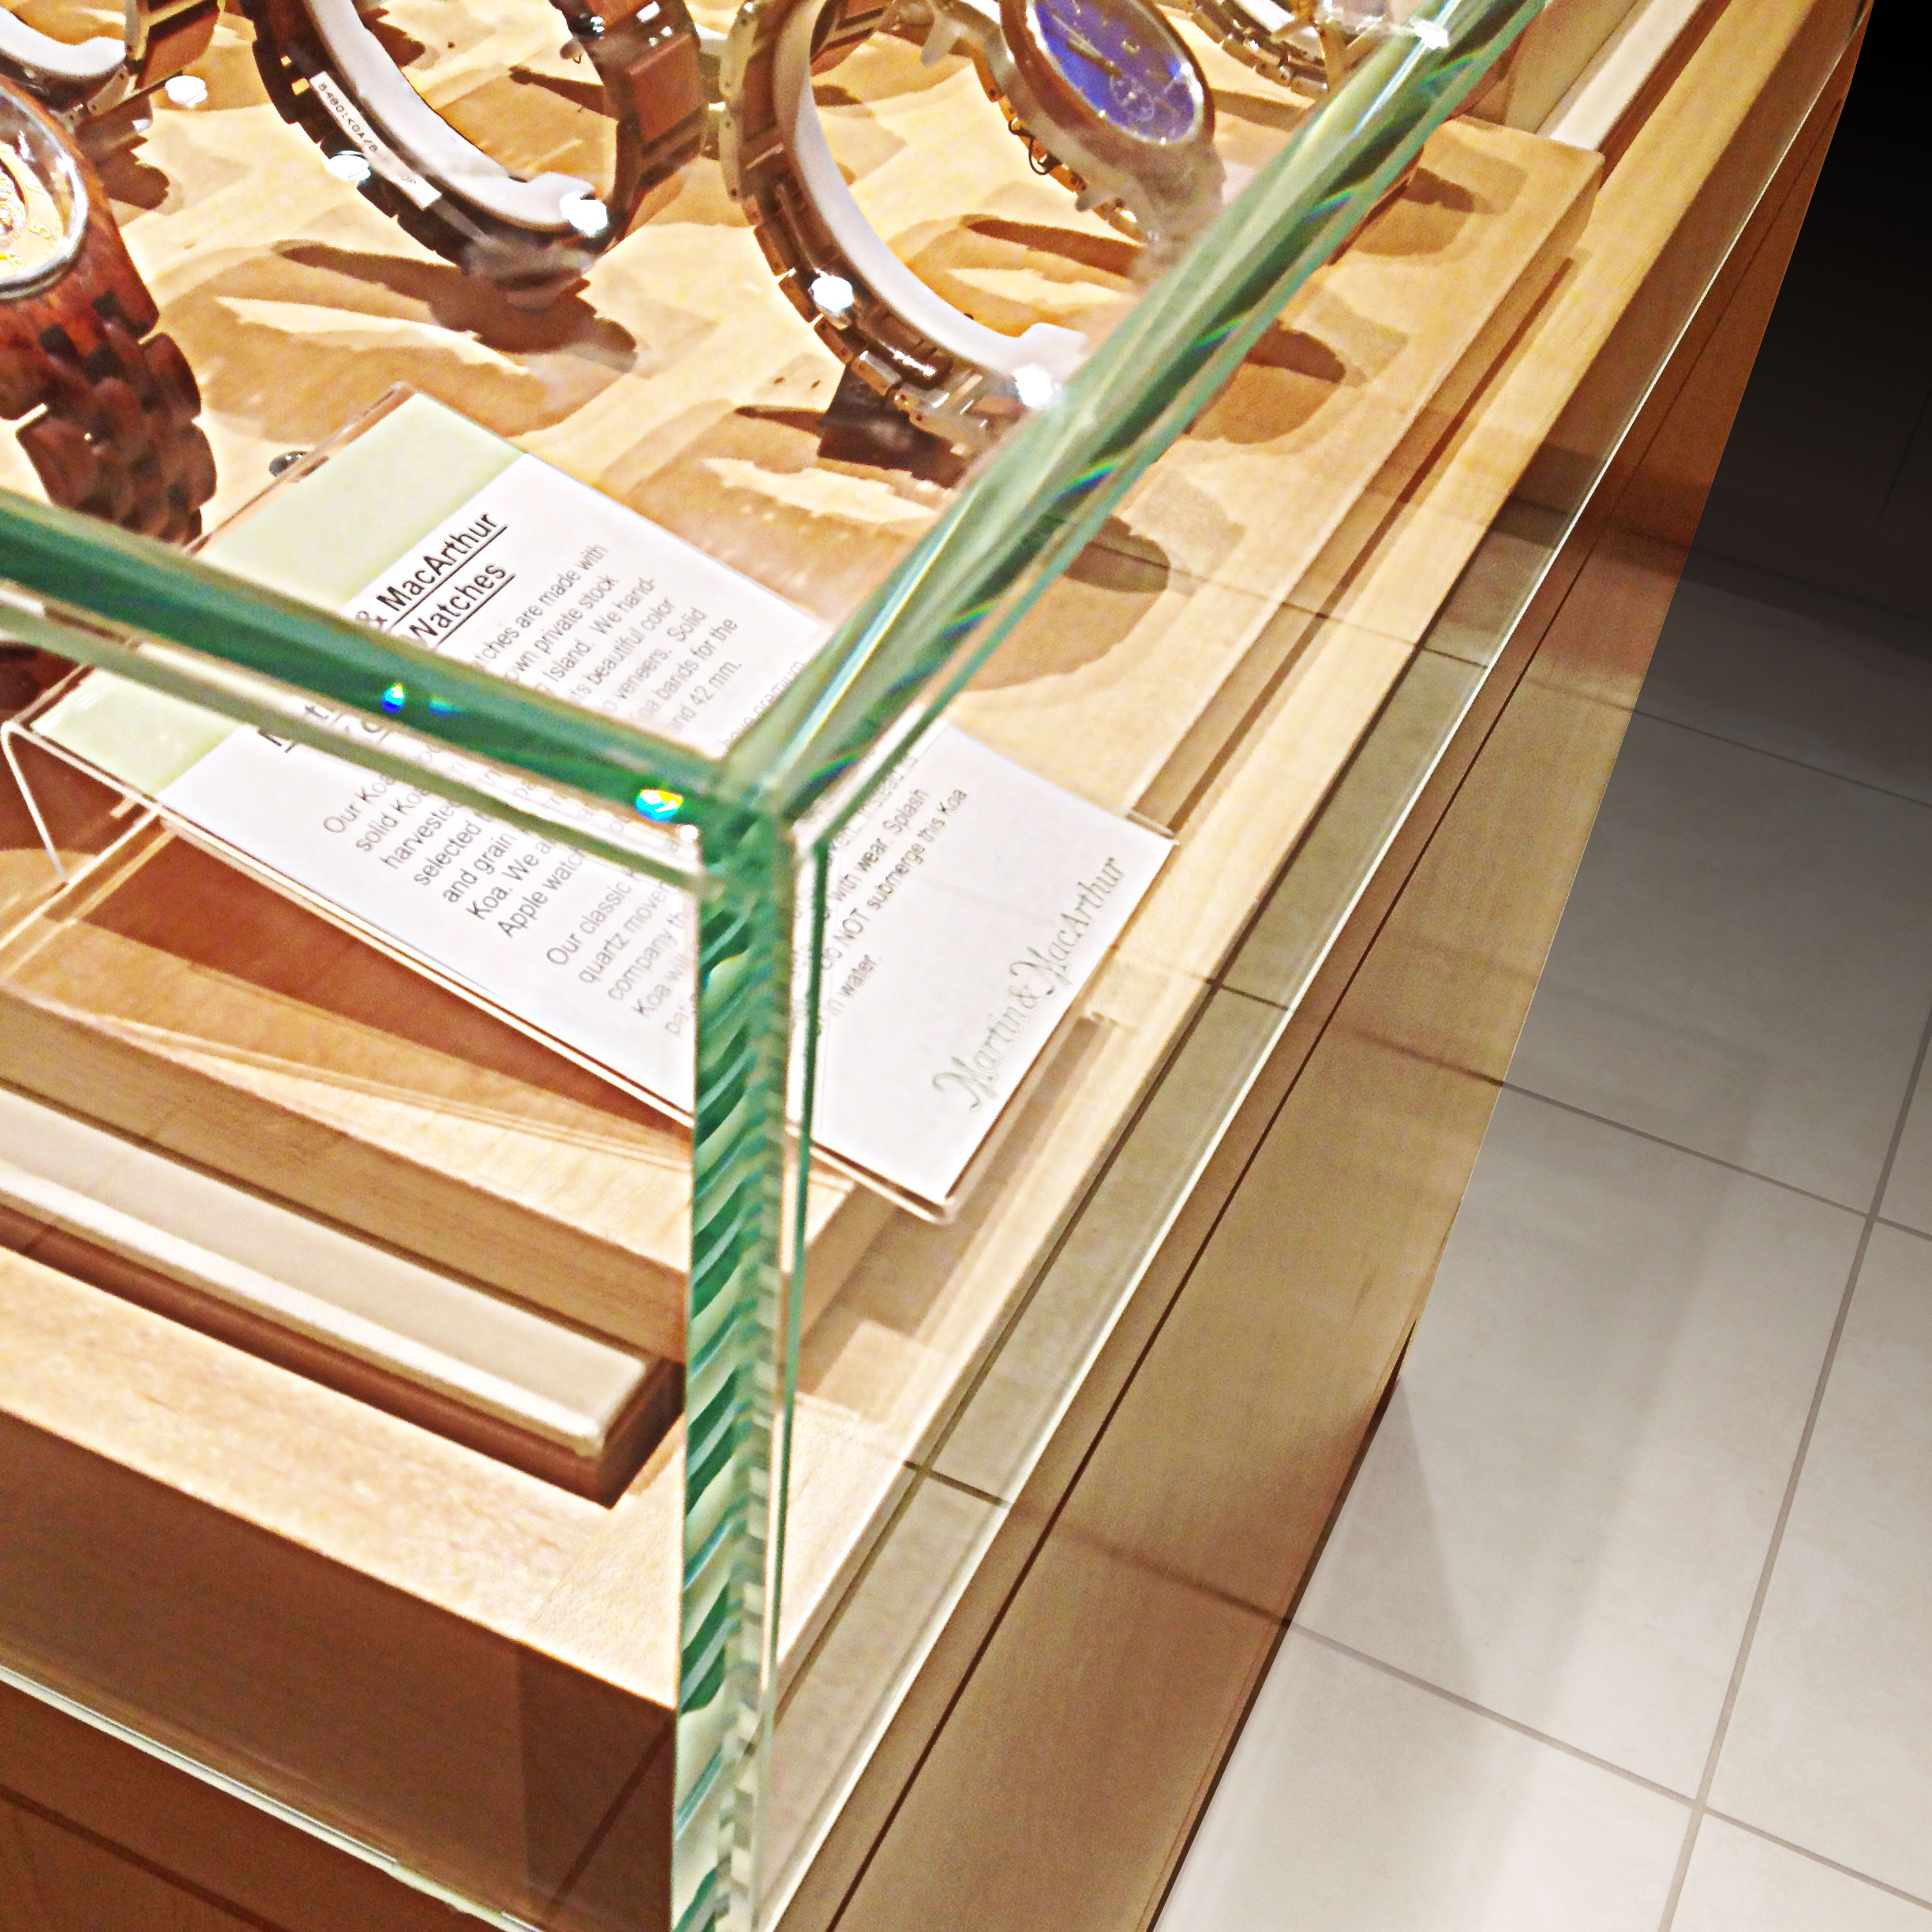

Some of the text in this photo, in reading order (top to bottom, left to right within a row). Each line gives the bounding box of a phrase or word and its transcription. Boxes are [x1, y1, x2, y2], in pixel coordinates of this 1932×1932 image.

[376, 513, 497, 612] MacArthur
[409, 564, 506, 639] Watches
[323, 801, 362, 833] Our
[474, 626, 519, 665] tches
[515, 605, 543, 629] are
[538, 569, 581, 607] made
[575, 544, 610, 571] with
[355, 812, 399, 852] solid
[534, 607, 583, 655] private
[578, 575, 620, 609] stock
[379, 800, 461, 870] harveste
[588, 610, 622, 635] We
[413, 819, 482, 886] selected
[583, 626, 646, 685] beautiful
[640, 597, 676, 631] color
[442, 867, 479, 904] and
[473, 831, 519, 875] grain
[612, 648, 672, 700] veneers.
[667, 606, 707, 642] Solid
[465, 886, 514, 920] Koa.
[501, 852, 540, 882] We
[651, 658, 700, 701] bands
[691, 638, 717, 661] for
[709, 619, 739, 642] the
[497, 889, 549, 939] Apple
[541, 848, 588, 892] watc
[689, 684, 716, 706] 42
[709, 661, 743, 691] mm.
[832, 873, 862, 902] with
[882, 788, 930, 835] Splash
[546, 932, 582, 966] Our
[579, 881, 632, 934] classic
[833, 907, 871, 949] NOT
[866, 841, 927, 911] submerge
[916, 818, 945, 844] this
[935, 788, 969, 816] Koa
[578, 930, 631, 984] quartz
[607, 927, 679, 1001] company
[631, 983, 672, 1020] Koa
